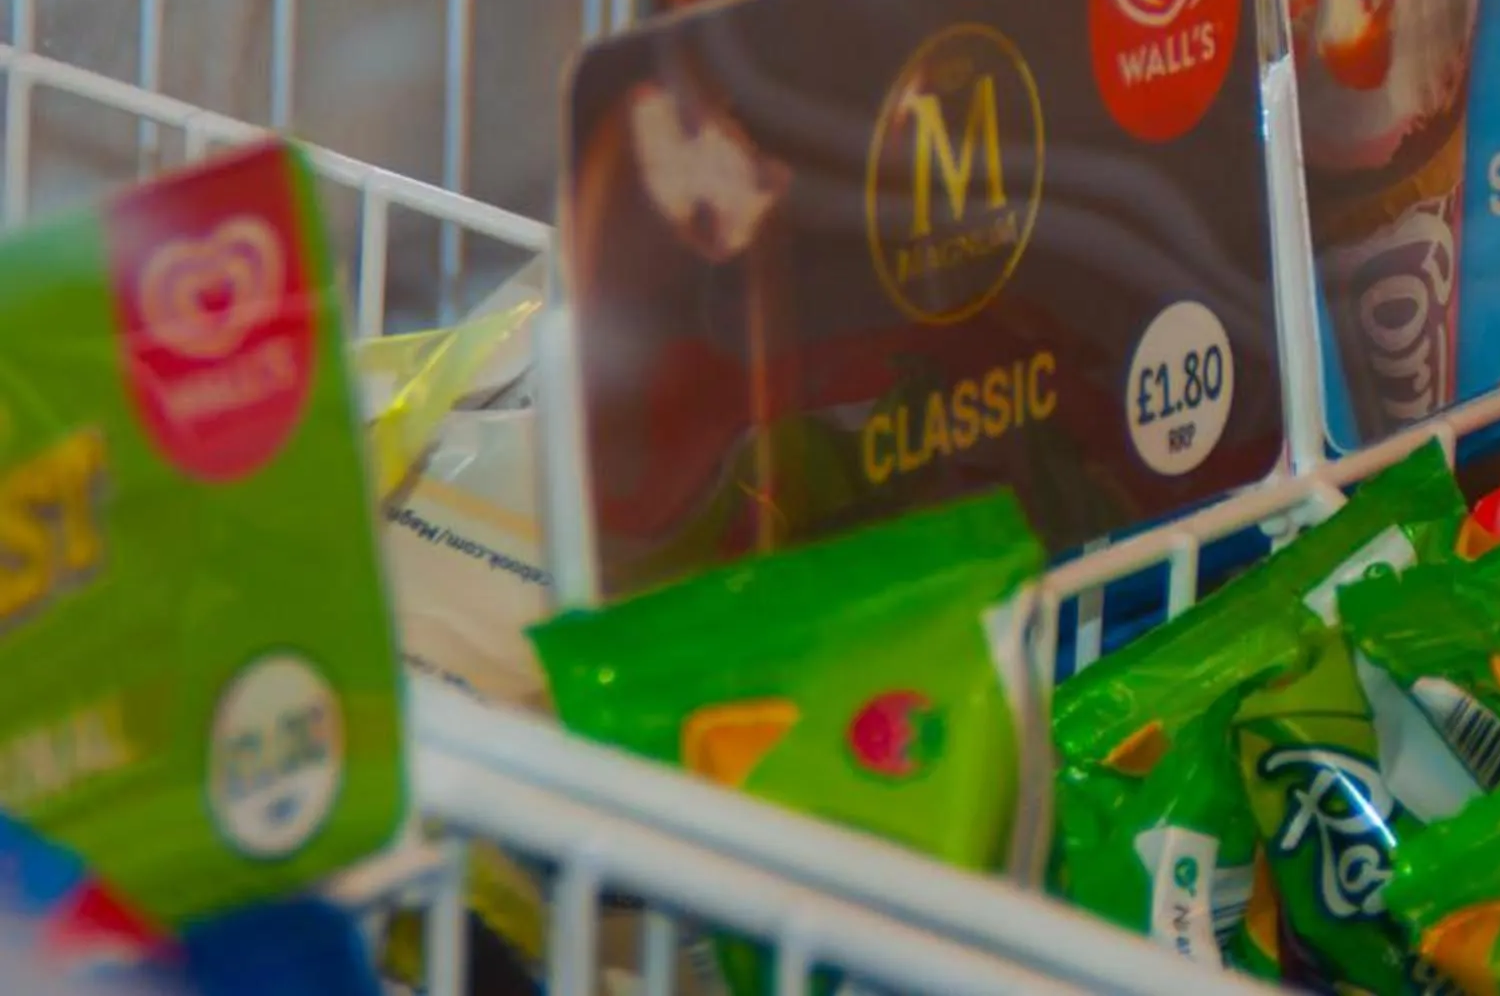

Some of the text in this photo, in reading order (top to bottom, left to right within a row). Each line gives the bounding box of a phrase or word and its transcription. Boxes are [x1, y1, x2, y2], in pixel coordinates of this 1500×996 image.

[1117, 23, 1216, 86] WALL'S
[862, 352, 1057, 484] CLASSIC
[1135, 344, 1224, 426] £1.80
[1167, 423, 1197, 456] RRP
